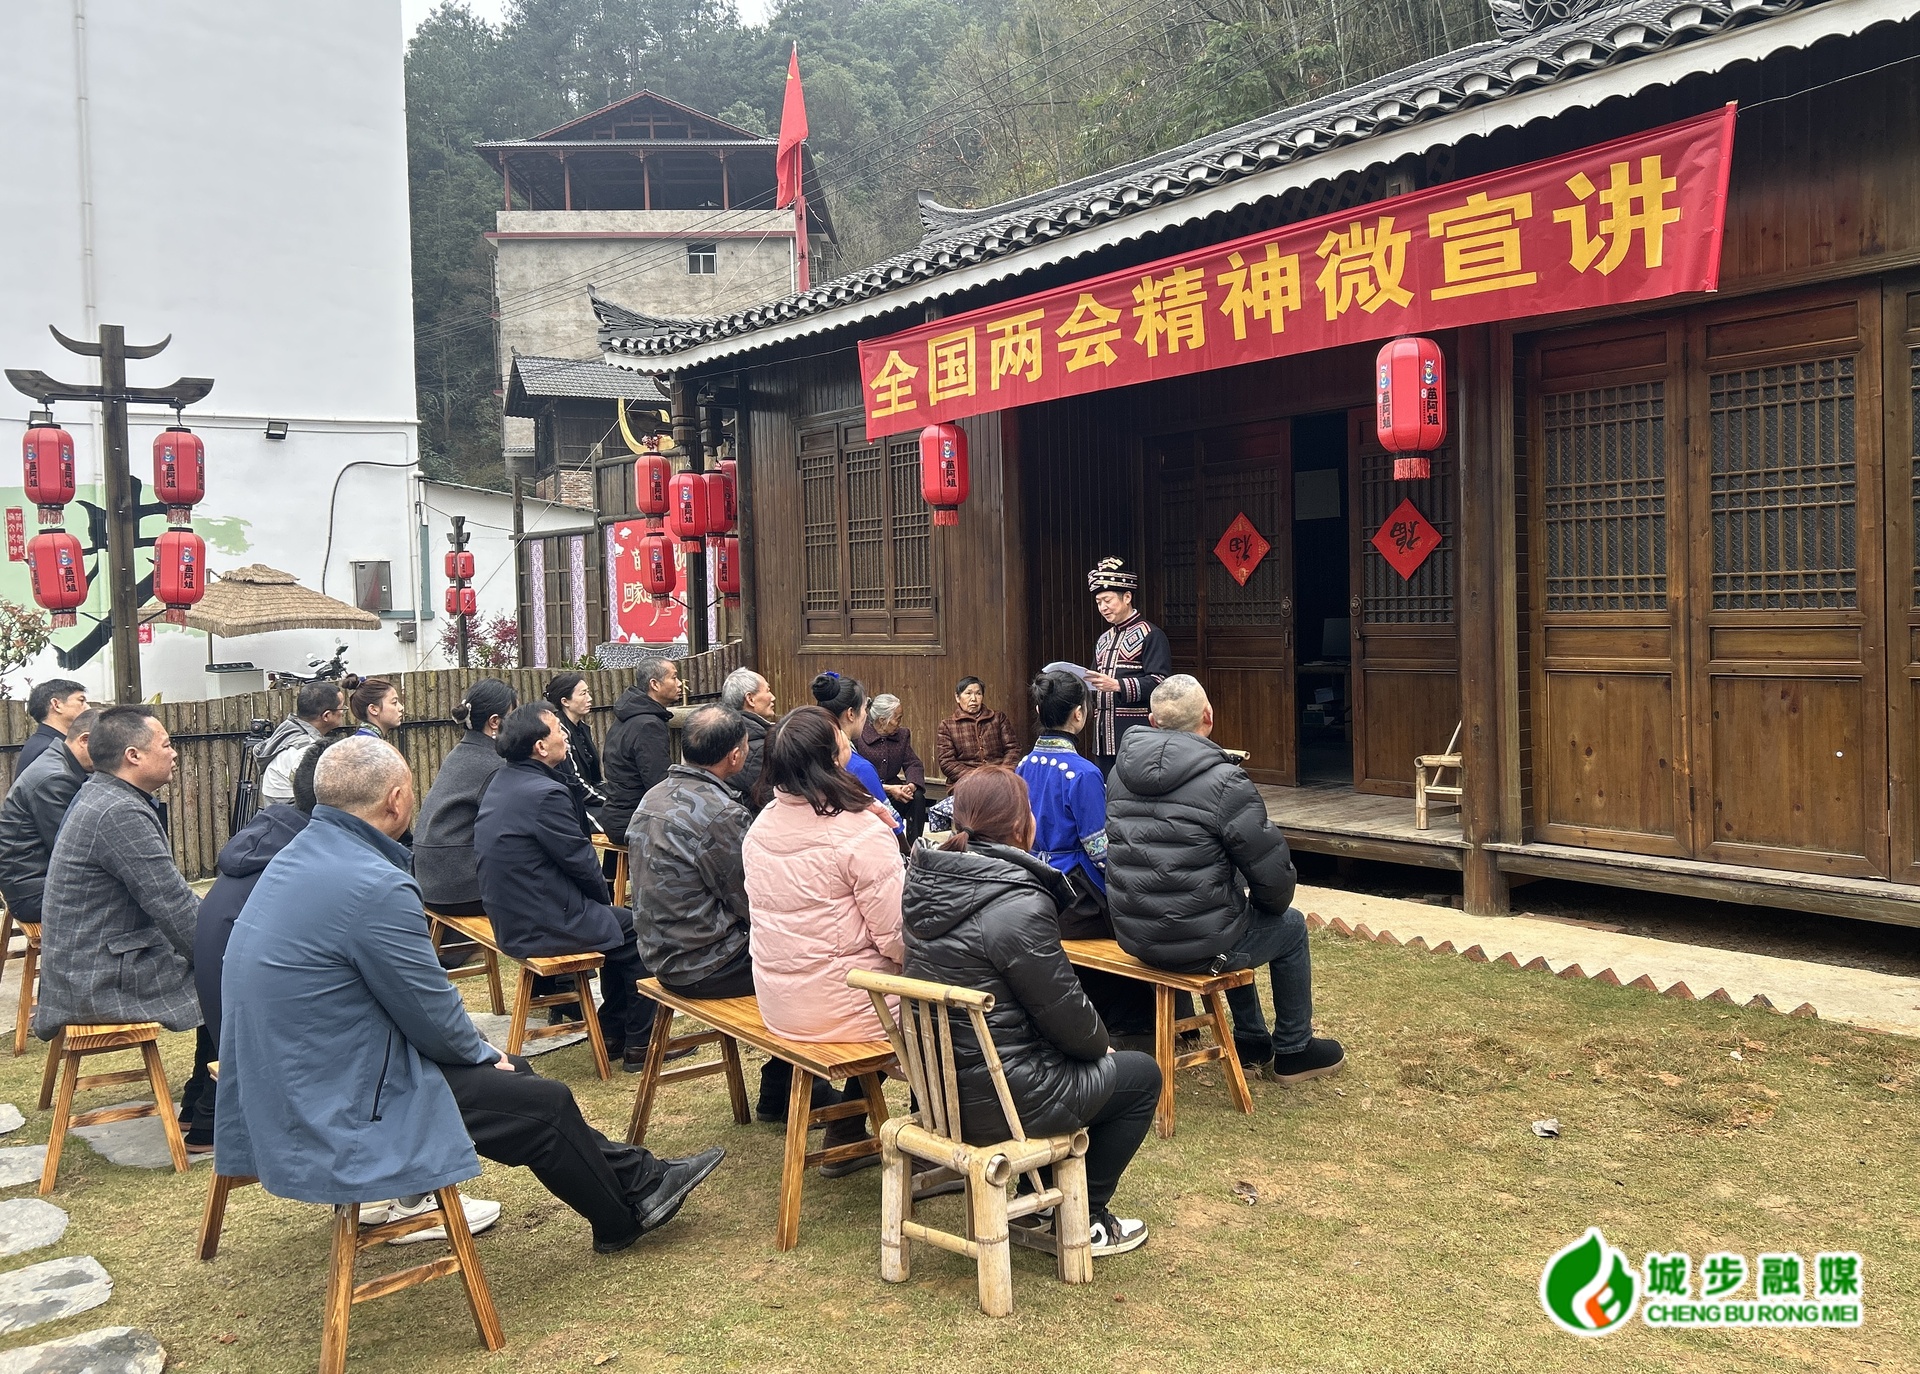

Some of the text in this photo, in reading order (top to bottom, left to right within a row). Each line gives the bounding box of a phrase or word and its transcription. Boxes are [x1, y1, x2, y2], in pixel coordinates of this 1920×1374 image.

[869, 154, 1682, 419] 全国两会精神微宣讲
[1427, 387, 1440, 425] 苗阿姐
[946, 460, 957, 488] 苗阿姐
[64, 566, 78, 592] 苗阿姐
[184, 564, 195, 589] 苗阿姐
